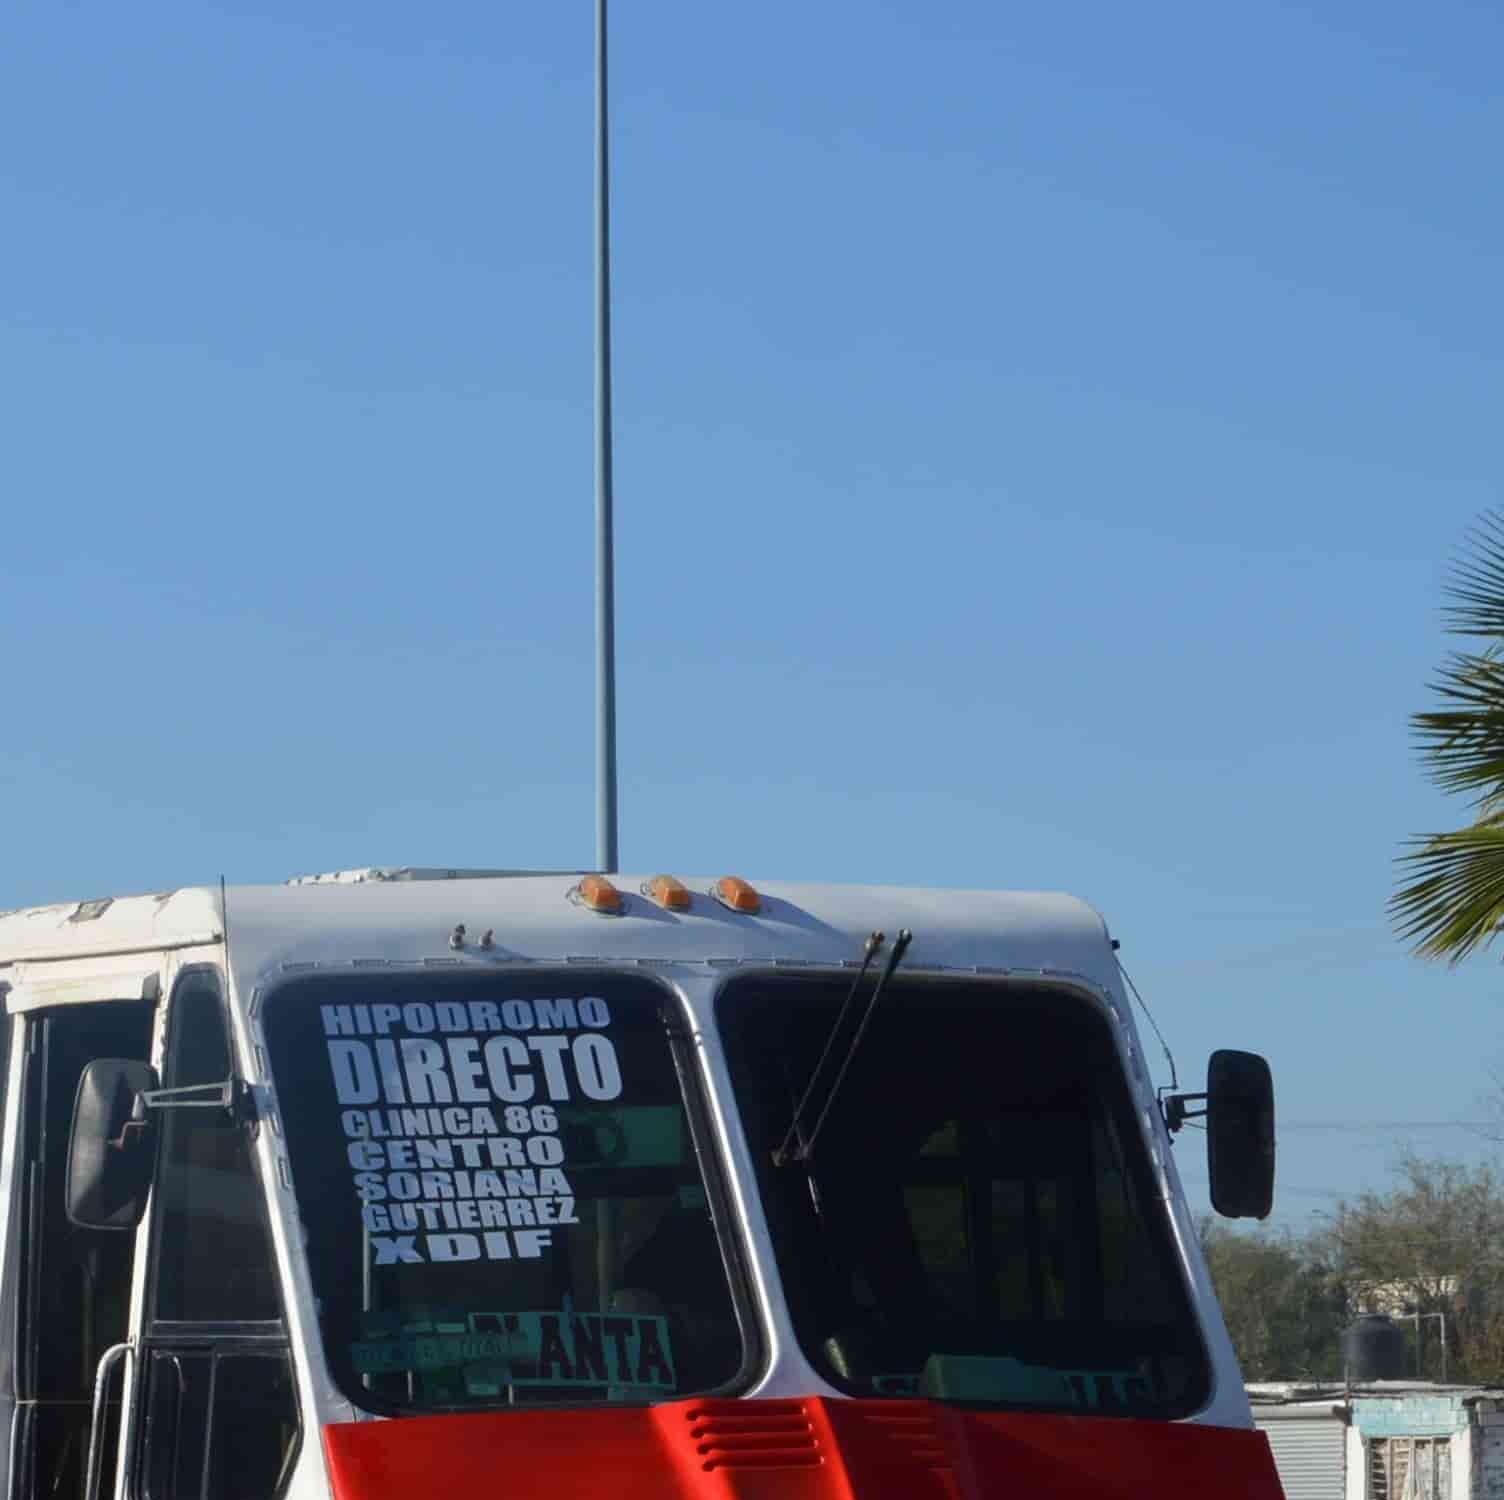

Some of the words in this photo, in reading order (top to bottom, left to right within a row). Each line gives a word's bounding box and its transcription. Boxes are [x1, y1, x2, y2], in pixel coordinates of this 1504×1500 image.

[320, 997, 611, 1035] HIPODROMO
[327, 1033, 623, 1105] DIRECTO
[342, 1106, 499, 1138] CLINICA
[504, 1104, 559, 1135] 86
[347, 1135, 565, 1171] CENTRO
[353, 1168, 574, 1201] SORIANA
[361, 1197, 580, 1233] GUTIERREZ
